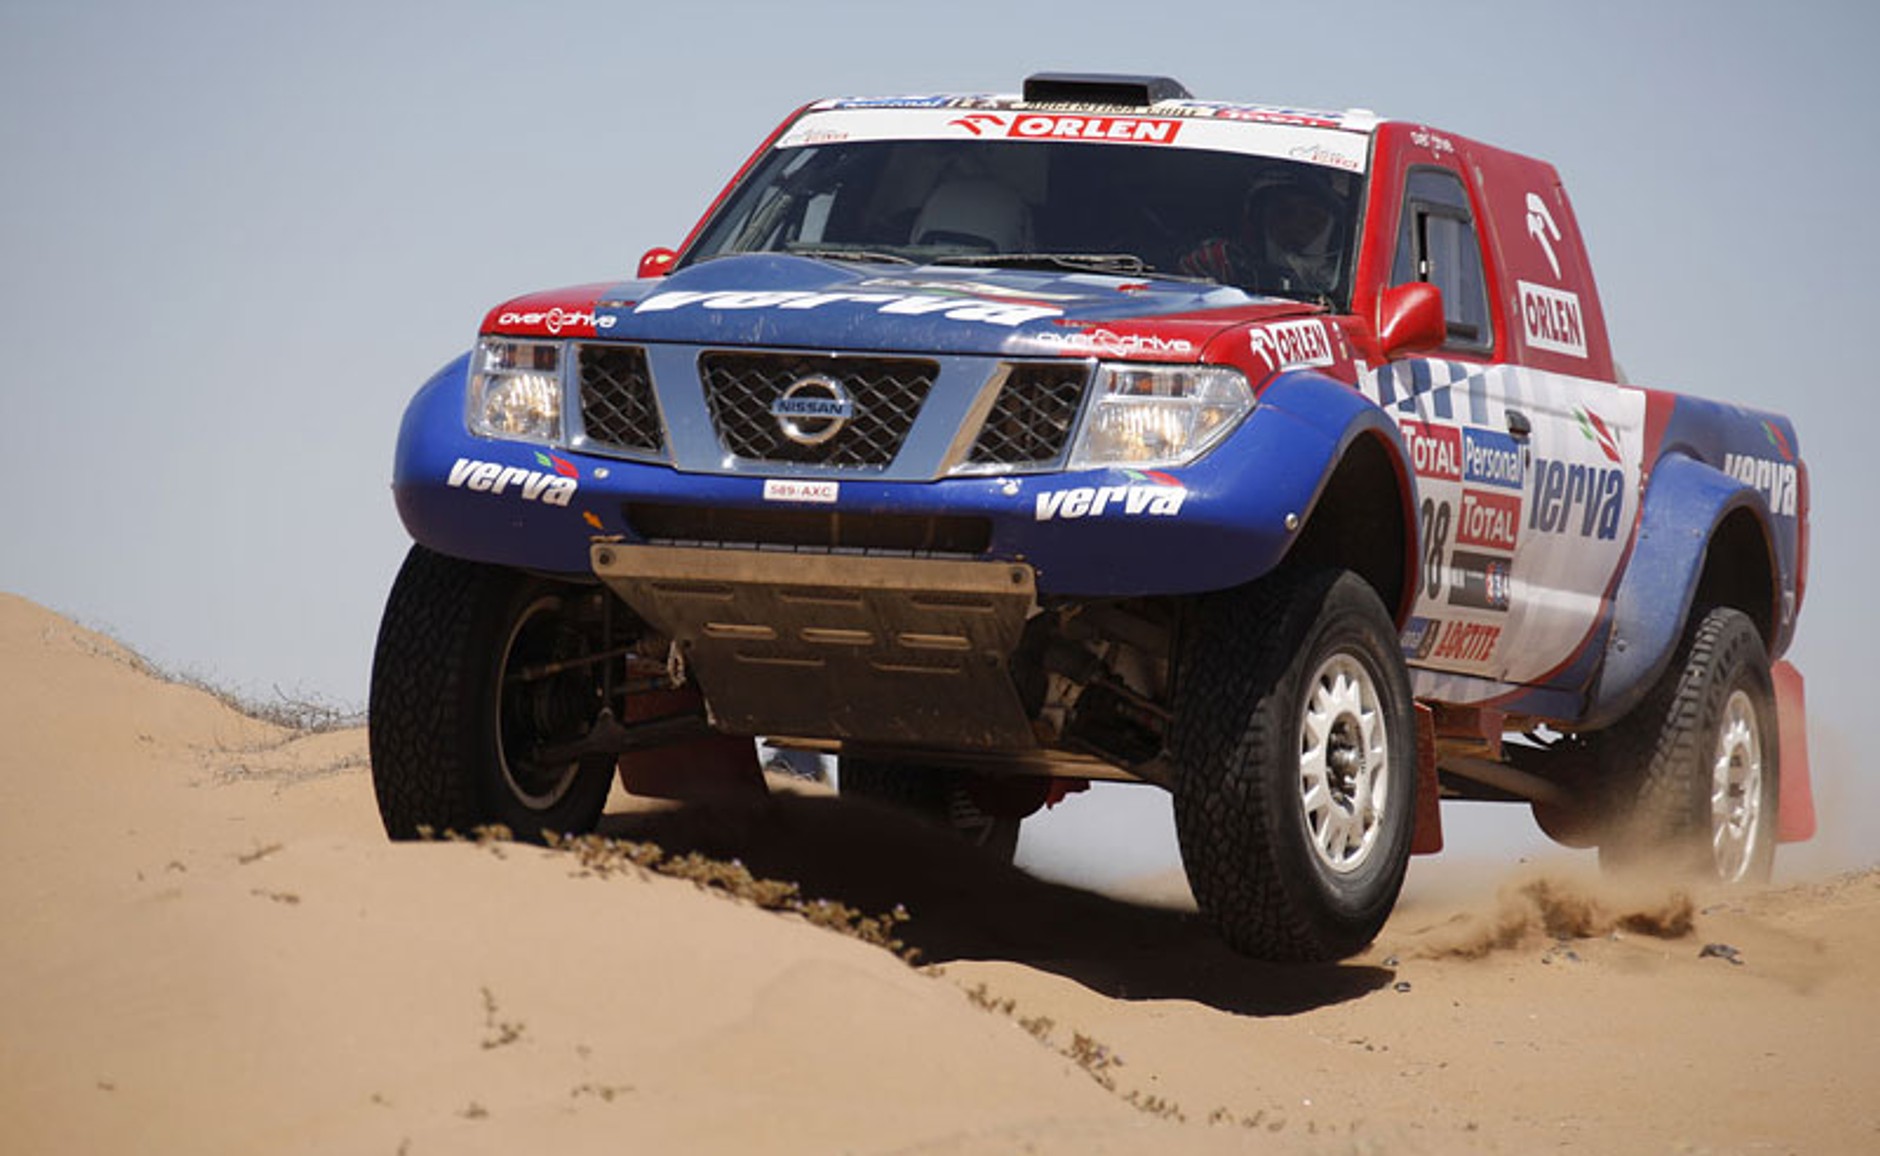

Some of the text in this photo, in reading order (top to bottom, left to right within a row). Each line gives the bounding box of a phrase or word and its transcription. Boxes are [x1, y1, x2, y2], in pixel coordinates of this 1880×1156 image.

[1018, 116, 1174, 141] ORLEN
[634, 291, 1064, 327] verva
[1524, 291, 1583, 347] ORLEN
[1274, 321, 1326, 363] ORLEN
[779, 400, 843, 415] NISSAN
[1402, 425, 1460, 475] TOTAL
[1465, 435, 1526, 483] Personal
[447, 458, 579, 507] verva
[1035, 485, 1189, 522] verva
[1462, 495, 1515, 543] TOTAL
[1433, 620, 1501, 661] LOCTITE
